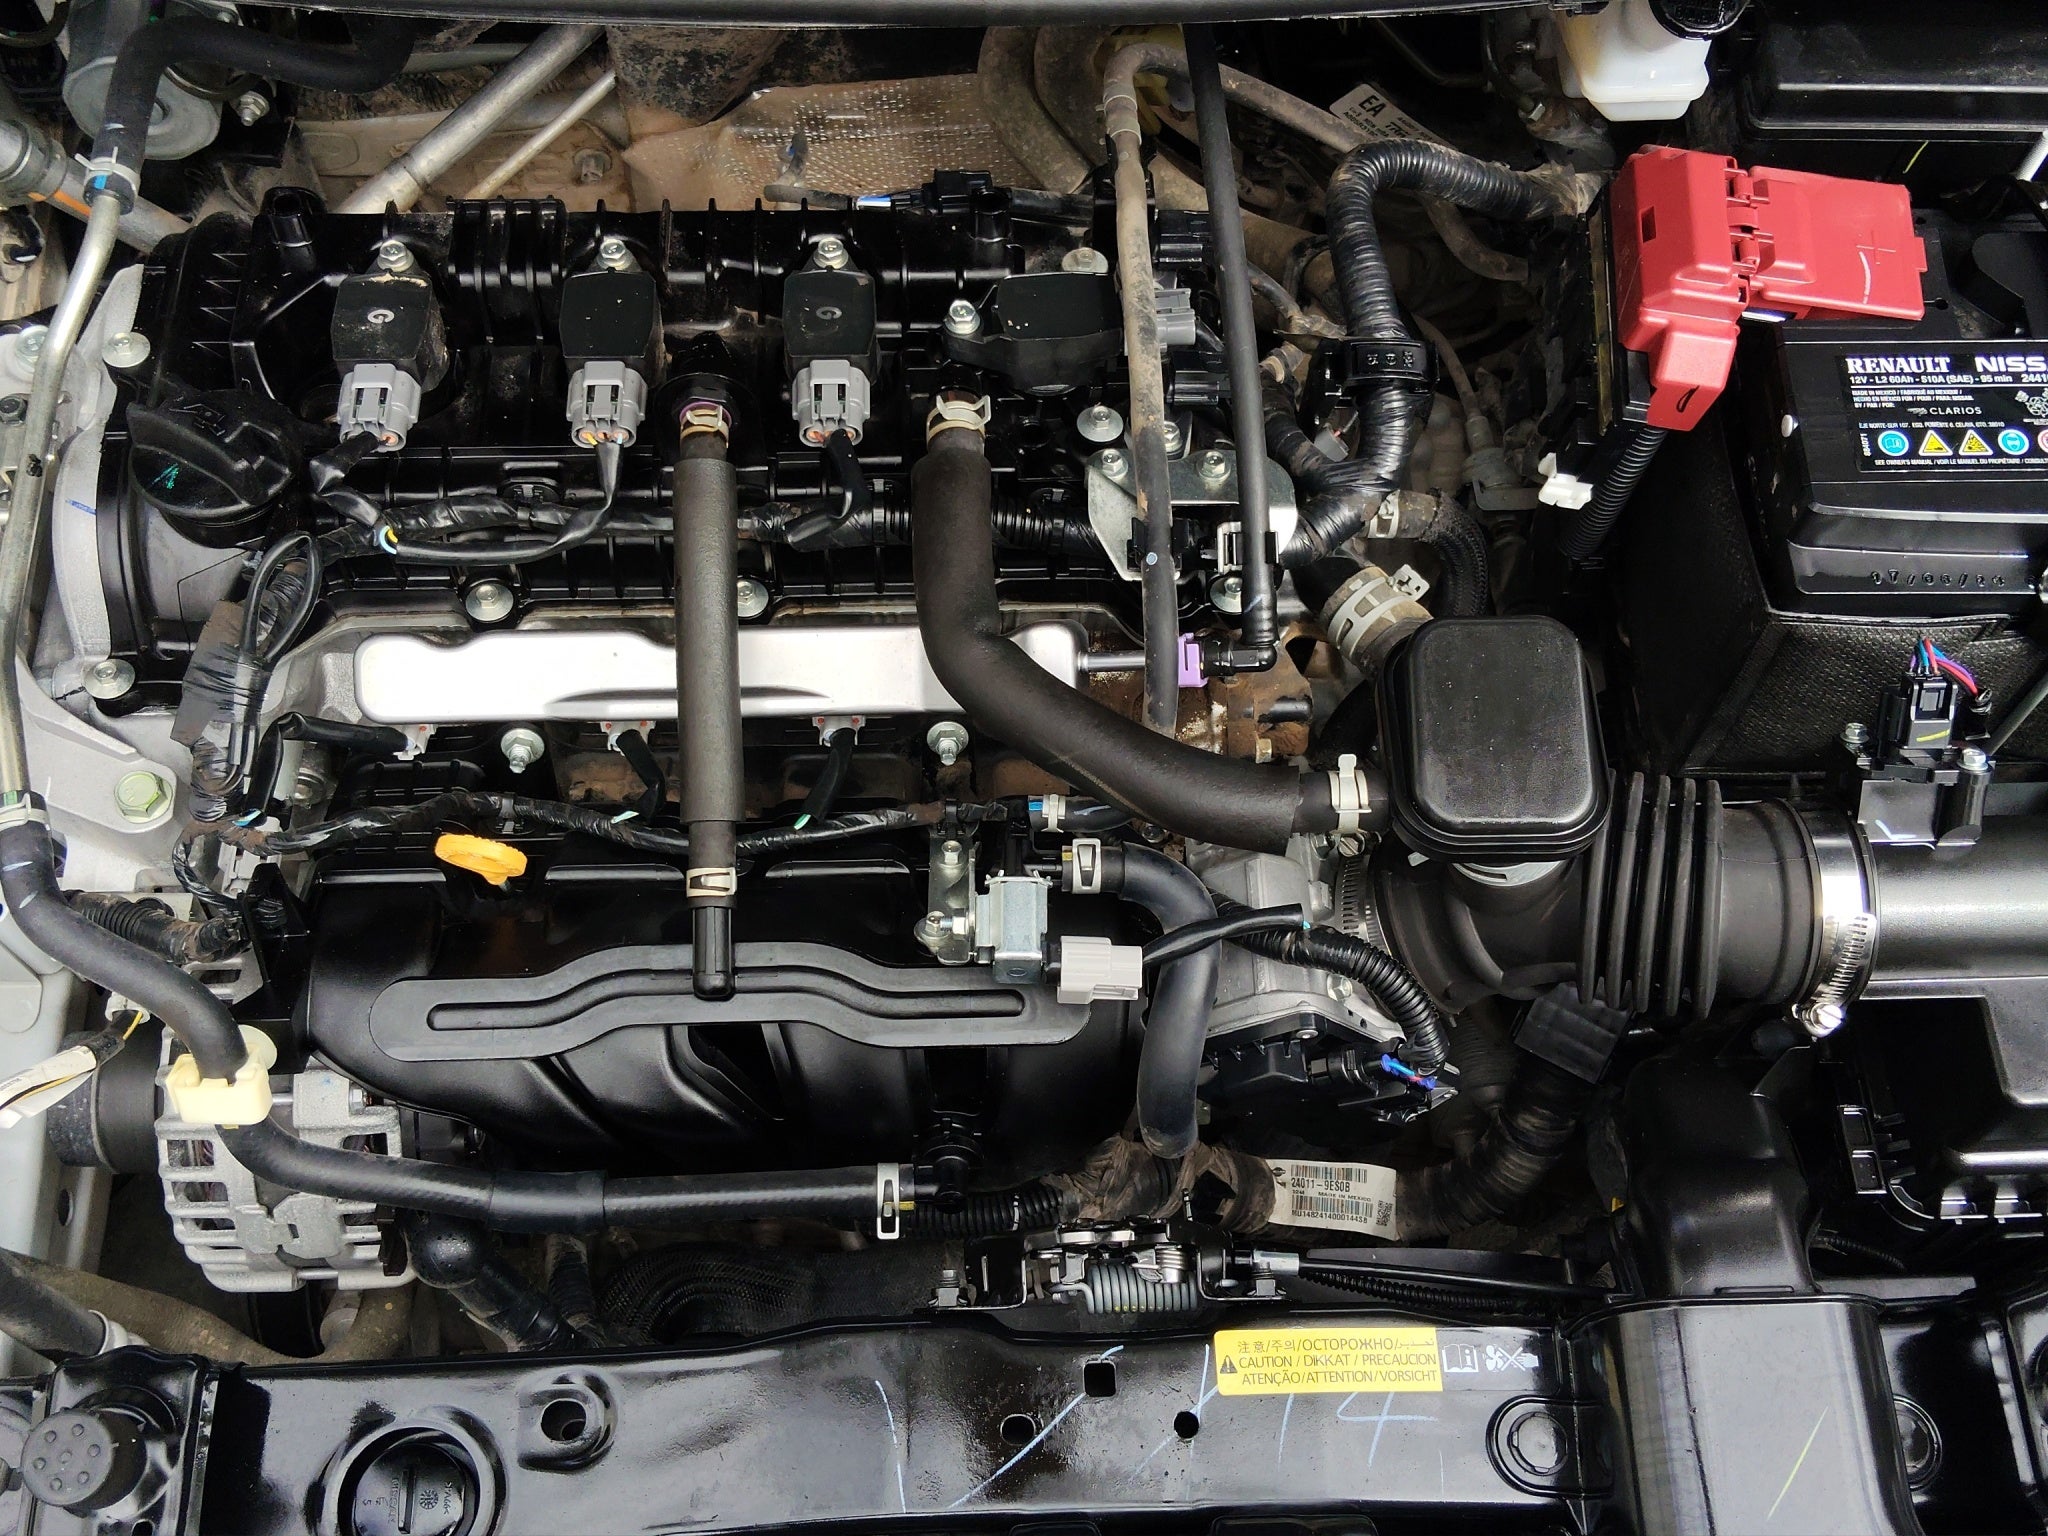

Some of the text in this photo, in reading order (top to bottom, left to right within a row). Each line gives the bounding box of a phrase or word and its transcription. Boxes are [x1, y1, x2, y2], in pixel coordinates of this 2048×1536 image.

[1845, 356, 2048, 373] RENAULT NISS
[1850, 376, 1868, 384] 12V
[1889, 375, 1914, 384] 60Ah
[1946, 375, 1974, 385] (SAE)
[1994, 375, 2013, 383] min
[1929, 406, 1982, 415] CLARIOS
[1239, 1356, 1292, 1368] CAUTION
[1304, 1354, 1350, 1366] DIKKAT
[1362, 1353, 1437, 1366] PRECAUCION
